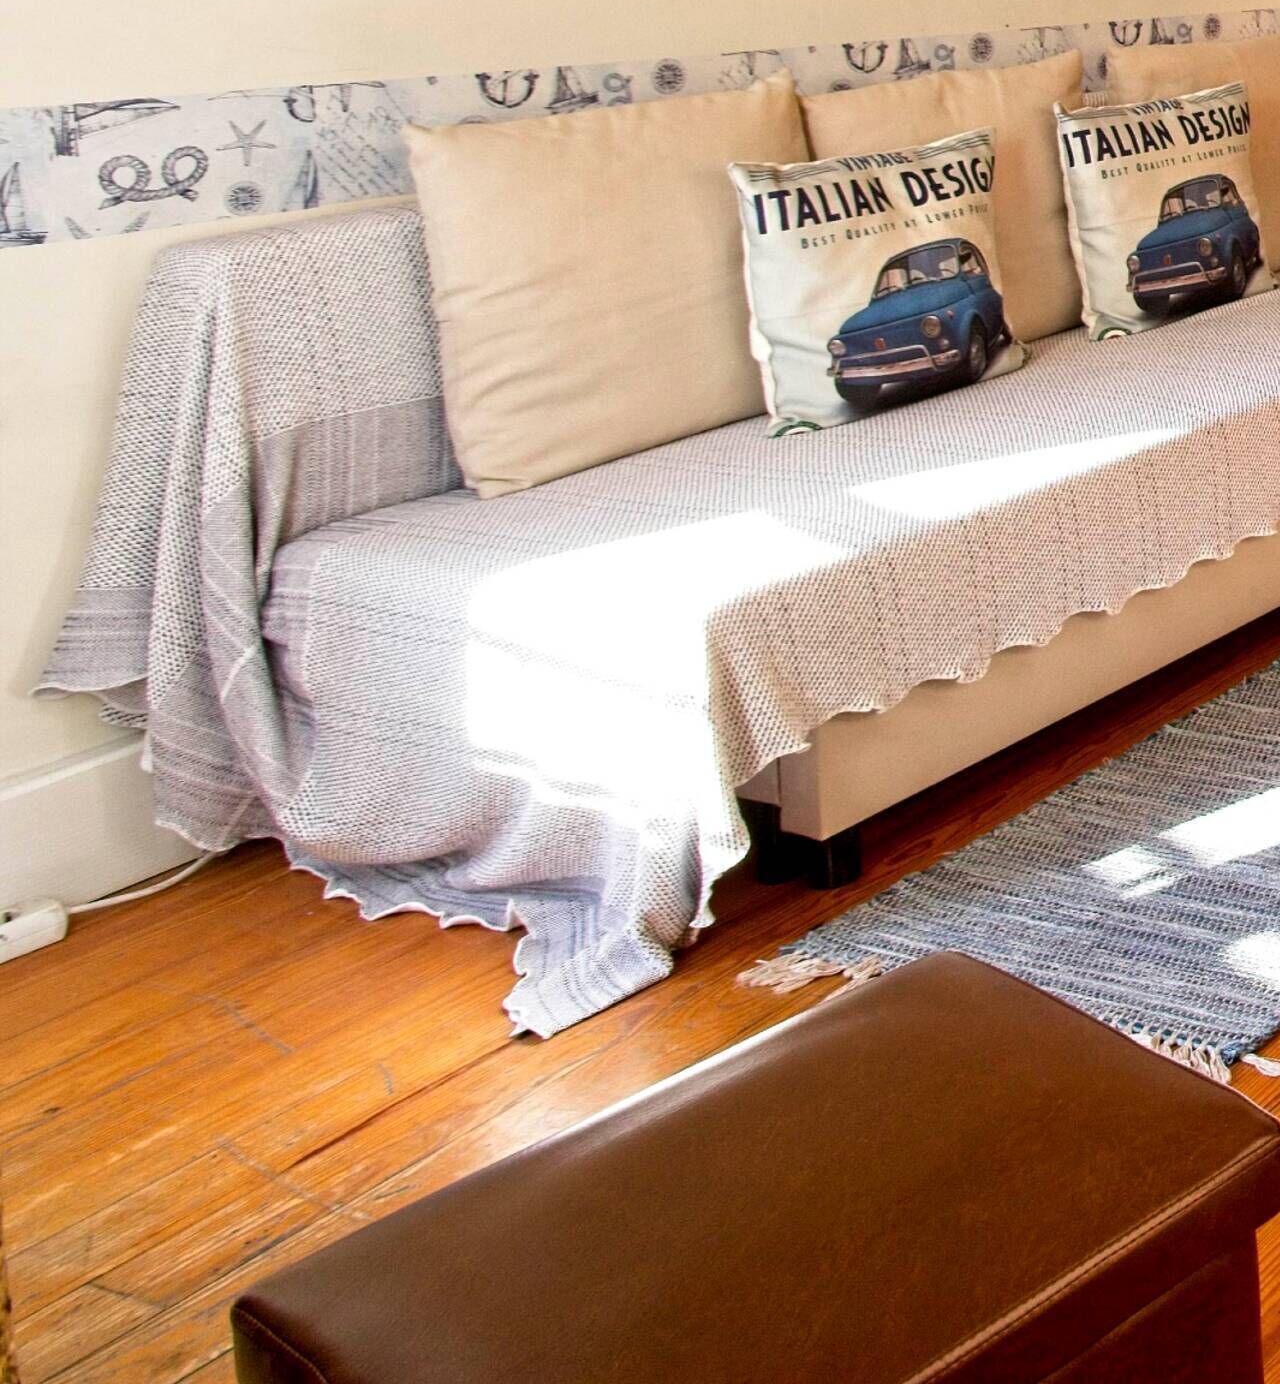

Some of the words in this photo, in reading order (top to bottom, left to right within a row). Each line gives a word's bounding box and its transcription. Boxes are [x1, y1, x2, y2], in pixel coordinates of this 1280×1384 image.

[1063, 119, 1175, 167] ITALIAN
[1177, 101, 1250, 145] DESIGN
[838, 152, 913, 172] VINTAGE
[1101, 167, 1129, 180] BEST
[1136, 158, 1176, 173] QUALITY
[753, 176, 894, 235] ITALIAN
[801, 233, 837, 250] BEST
[846, 222, 897, 241] QUALITY
